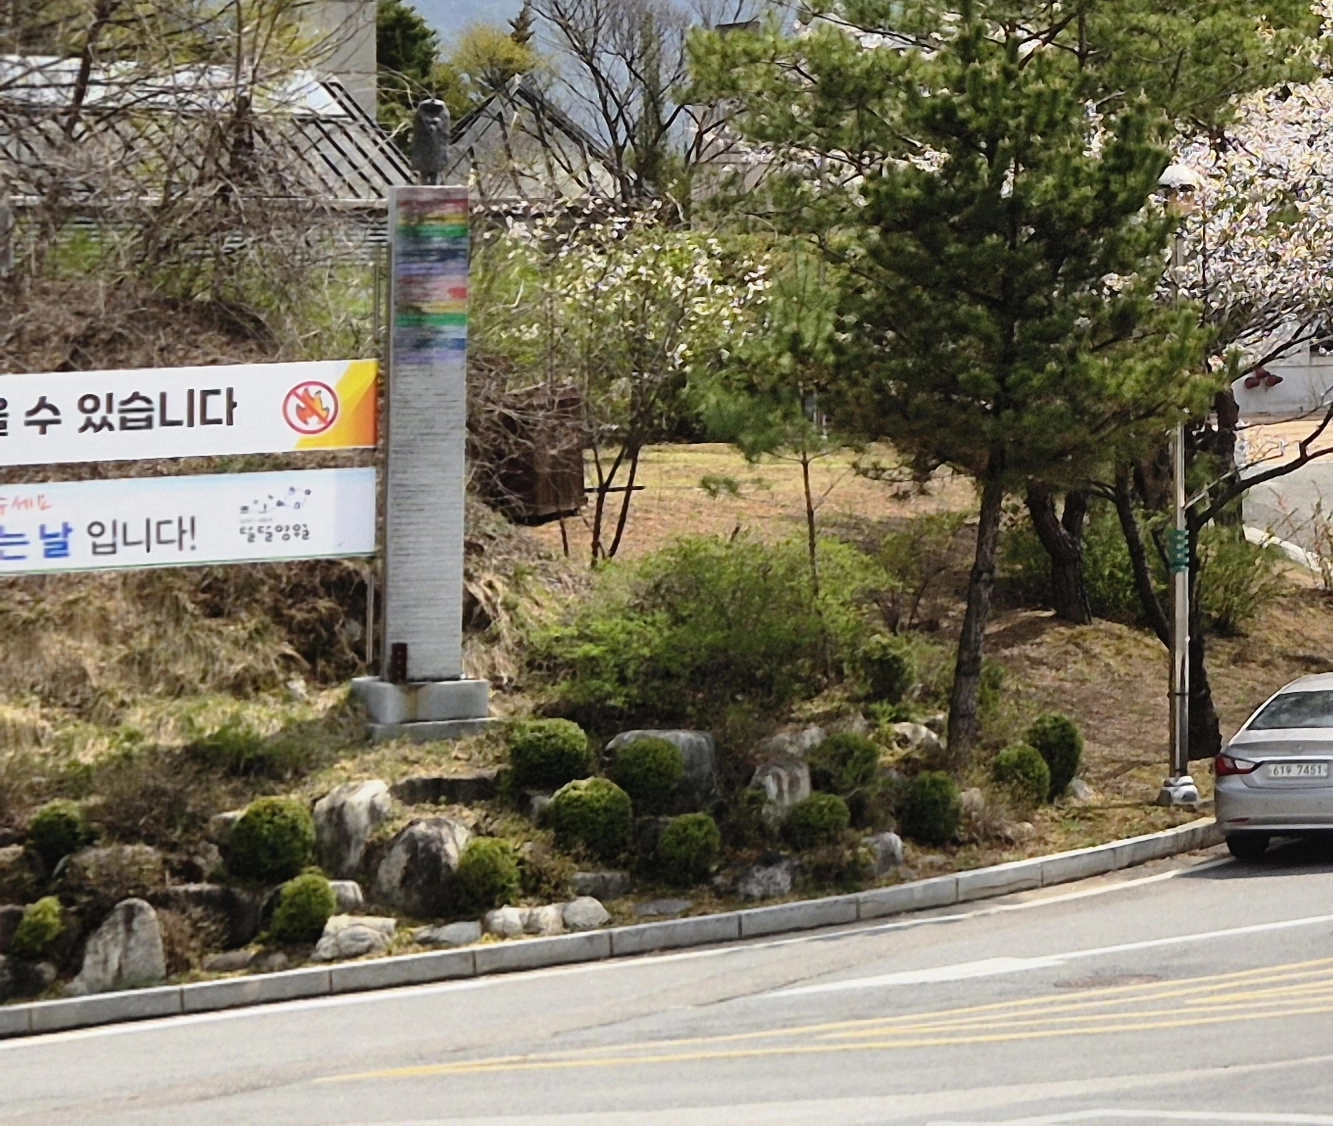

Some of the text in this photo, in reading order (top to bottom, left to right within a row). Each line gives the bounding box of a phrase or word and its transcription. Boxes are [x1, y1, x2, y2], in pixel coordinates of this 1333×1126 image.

[24, 395, 62, 436] 수
[77, 386, 238, 434] 있습니다
[39, 521, 73, 559] 날
[86, 515, 197, 557] 입니다!
